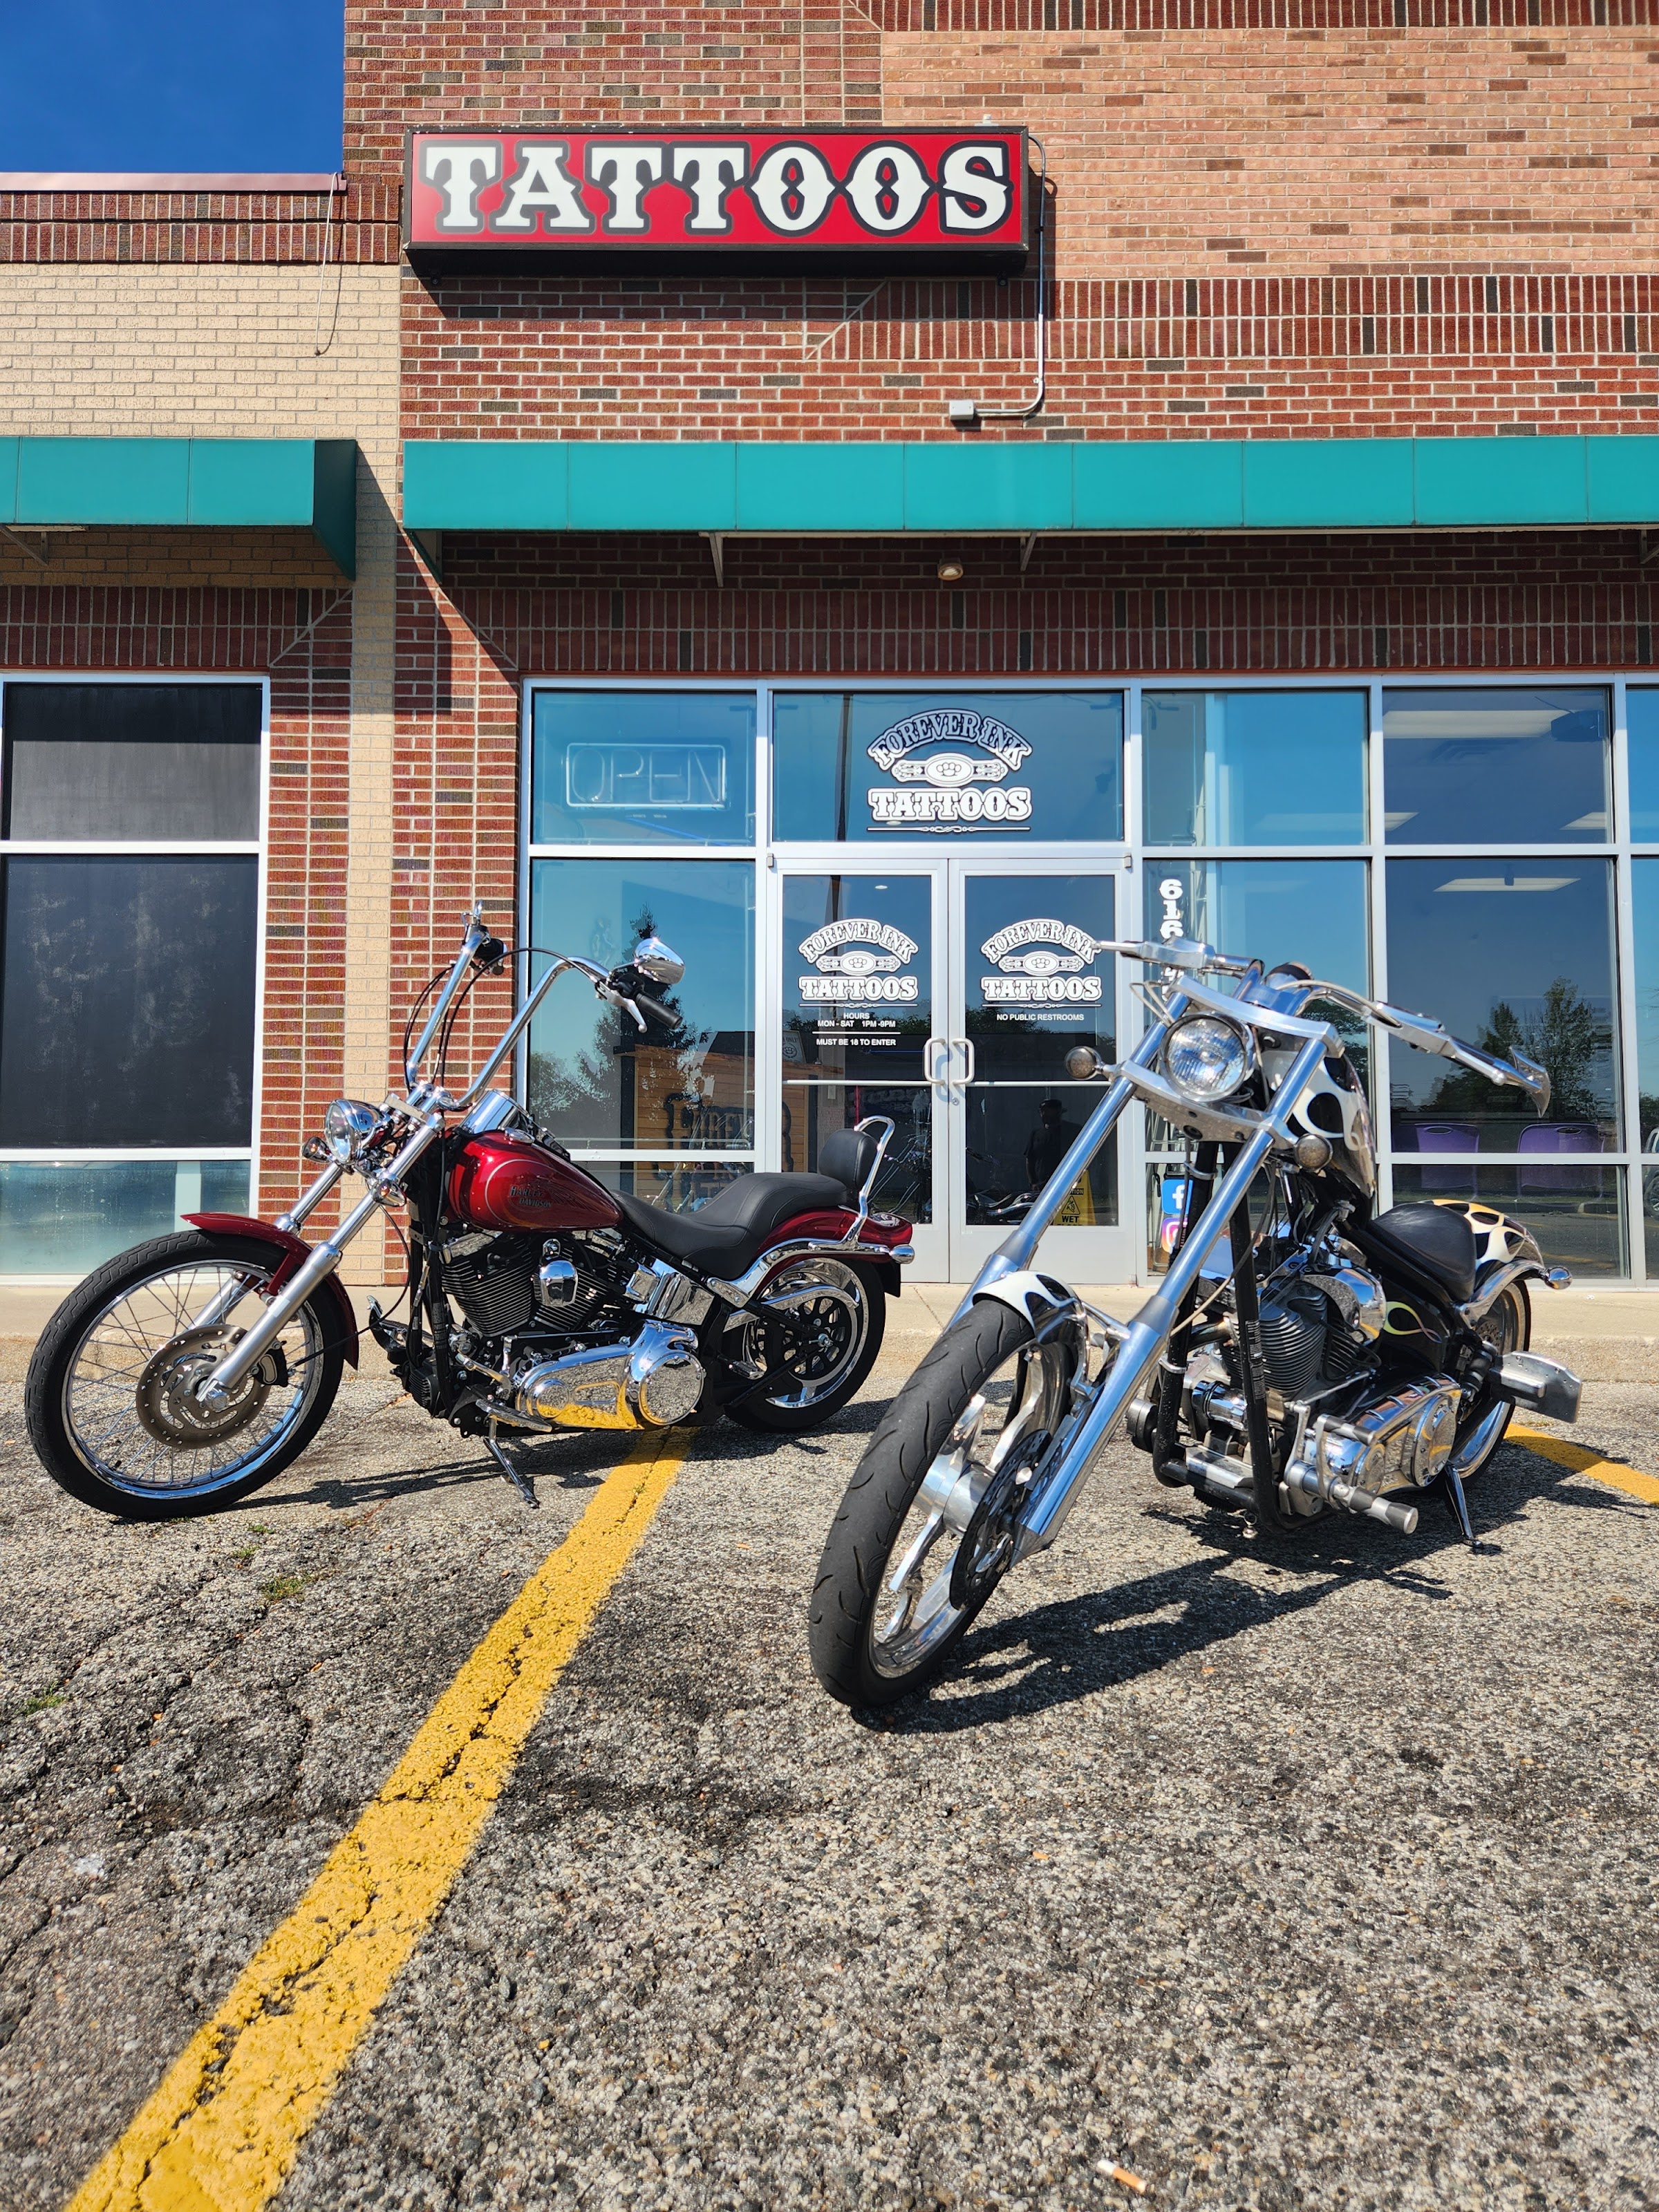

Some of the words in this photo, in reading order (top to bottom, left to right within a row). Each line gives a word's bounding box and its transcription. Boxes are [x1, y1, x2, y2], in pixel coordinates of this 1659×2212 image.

[422, 142, 1015, 234] TATTOOS
[870, 711, 980, 768] FOREVER
[980, 718, 1031, 769] INK
[571, 748, 721, 803] OPEN
[870, 789, 1031, 819] TATTOOS
[800, 920, 880, 962] FOREVER
[879, 926, 917, 962] INK
[982, 920, 1064, 962] FOREVER
[1063, 926, 1100, 962] INK
[800, 977, 917, 1000] TATTOOS
[982, 977, 1101, 1000] TATTOOS
[519, 1197, 552, 1208] DAVIDSON
